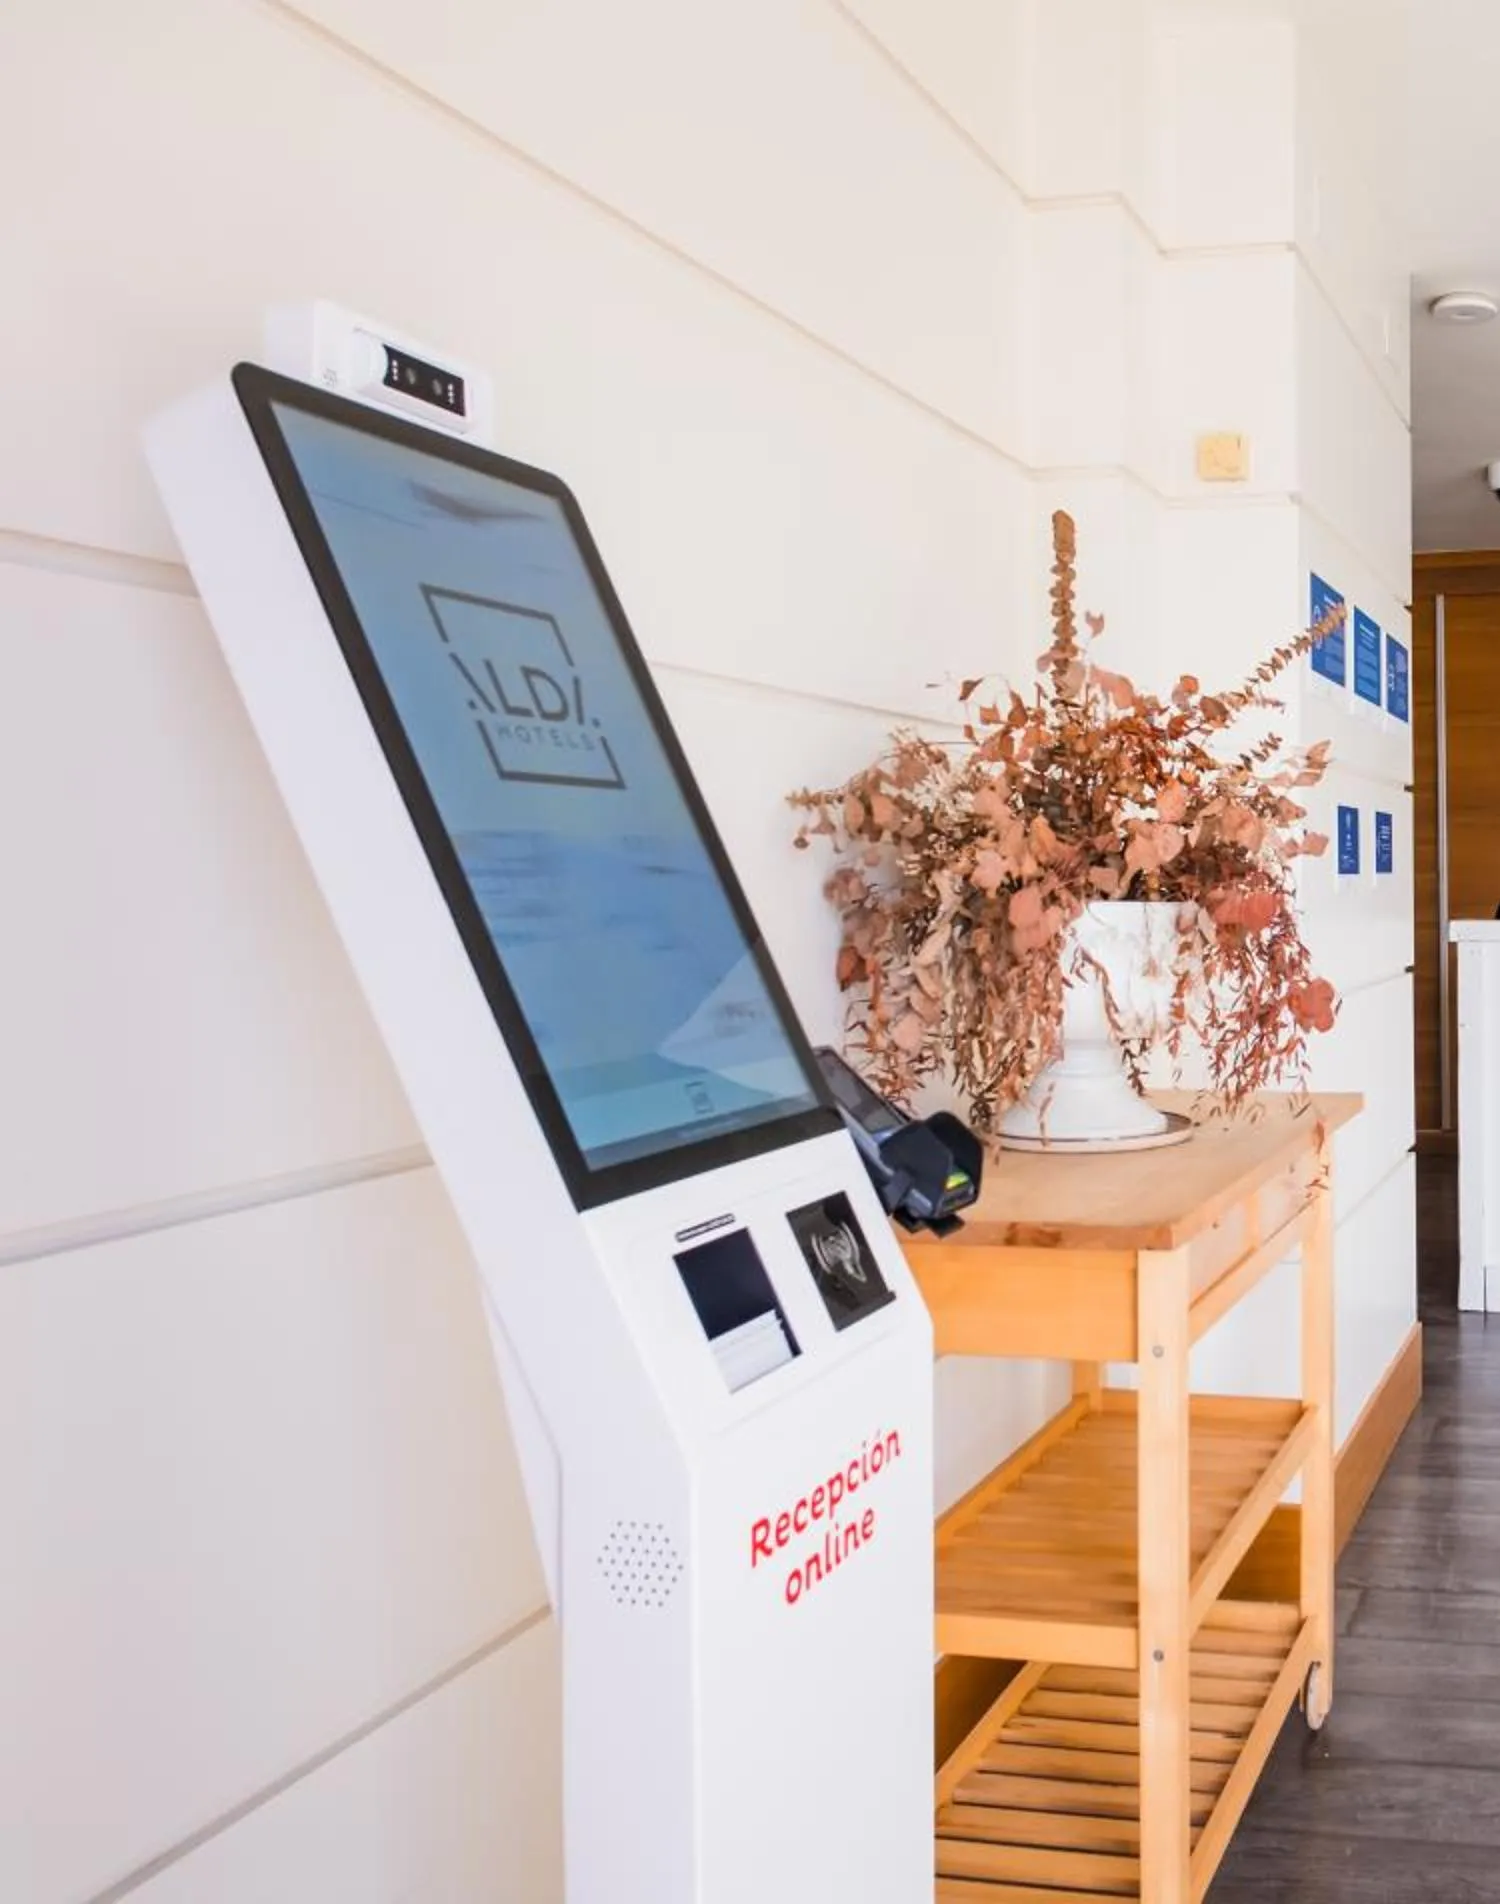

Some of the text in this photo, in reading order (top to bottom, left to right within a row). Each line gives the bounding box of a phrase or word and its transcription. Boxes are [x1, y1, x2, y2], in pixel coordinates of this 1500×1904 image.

[496, 722, 596, 751] HOTELS
[751, 1428, 901, 1568] Recepción
[785, 1507, 874, 1604] online
